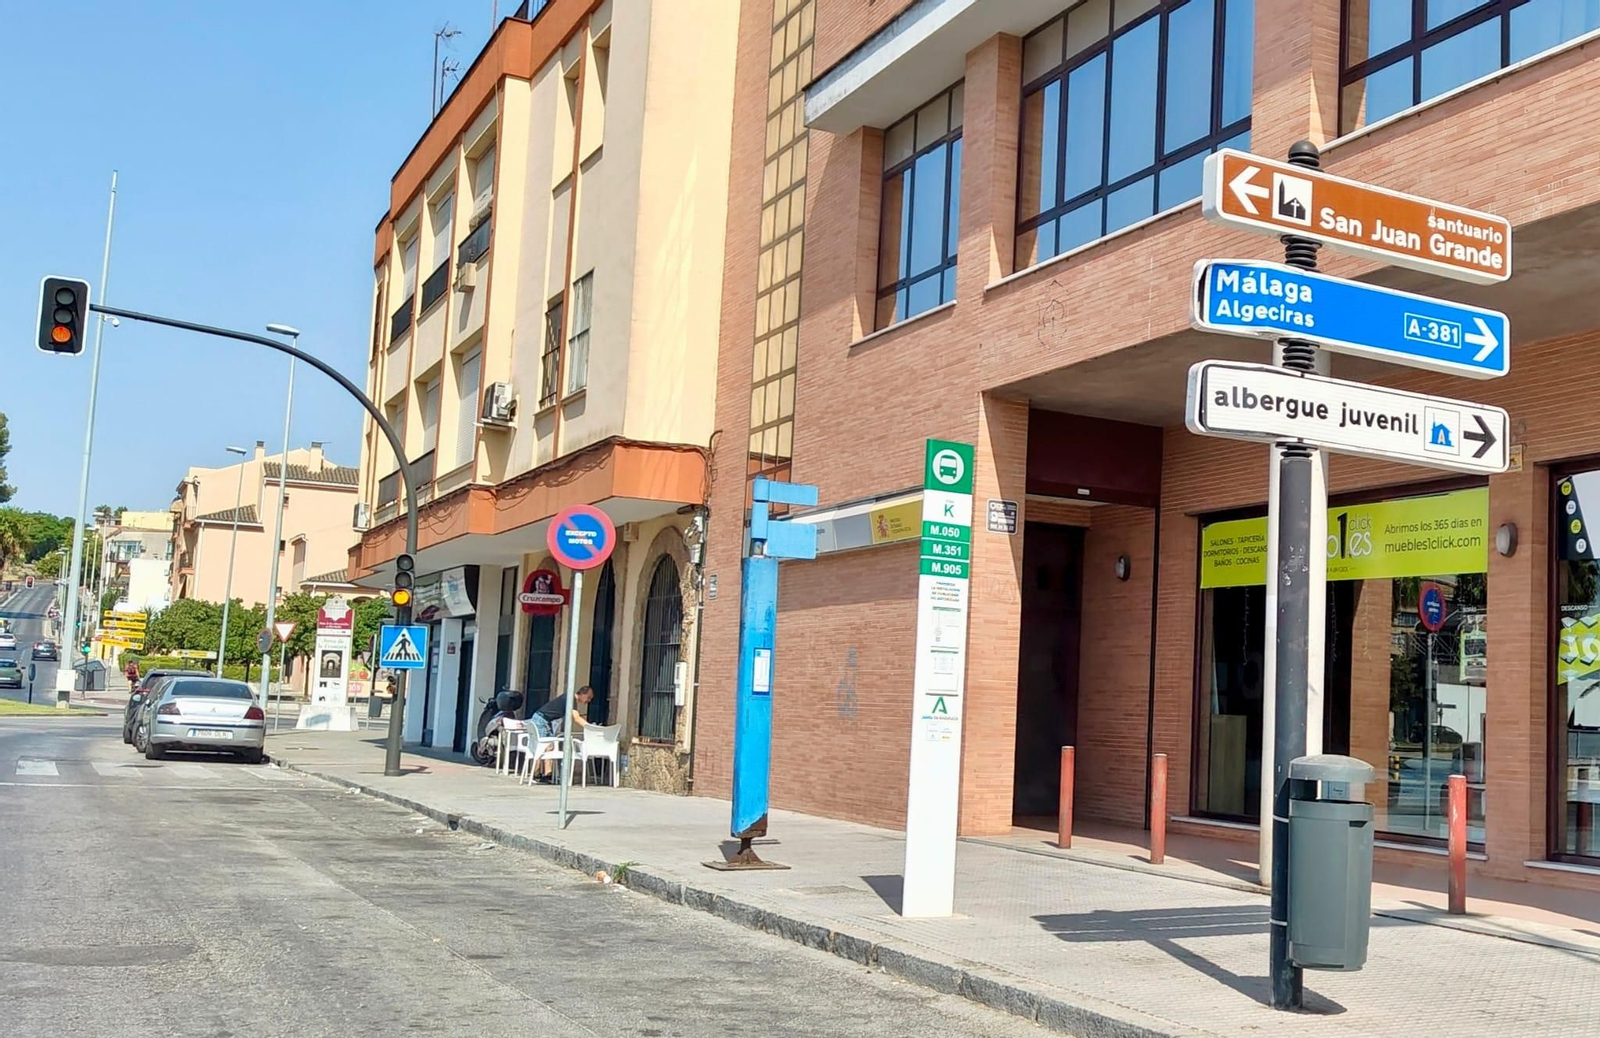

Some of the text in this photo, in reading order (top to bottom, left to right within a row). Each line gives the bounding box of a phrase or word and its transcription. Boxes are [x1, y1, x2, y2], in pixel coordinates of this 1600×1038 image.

[1427, 213, 1503, 244] santuario
[1319, 207, 1503, 270] San Juan Grande
[1215, 269, 1313, 304] Málaga
[1215, 301, 1460, 344] Algeciras A-381
[1214, 385, 1419, 436] albergue juvenil
[944, 504, 955, 518] K
[929, 524, 960, 538] M.050
[1384, 517, 1482, 535] Abrimos los 365 días en
[931, 542, 962, 556] M.351
[1209, 537, 1234, 547] SALONES
[1384, 535, 1481, 554] muebles1click.com
[1203, 545, 1268, 558] DORMITORIOS DESCANS
[930, 561, 962, 575] M.905
[1213, 555, 1260, 567] BAÑOS COCINAS
[1560, 604, 1588, 612] DESCANSO
